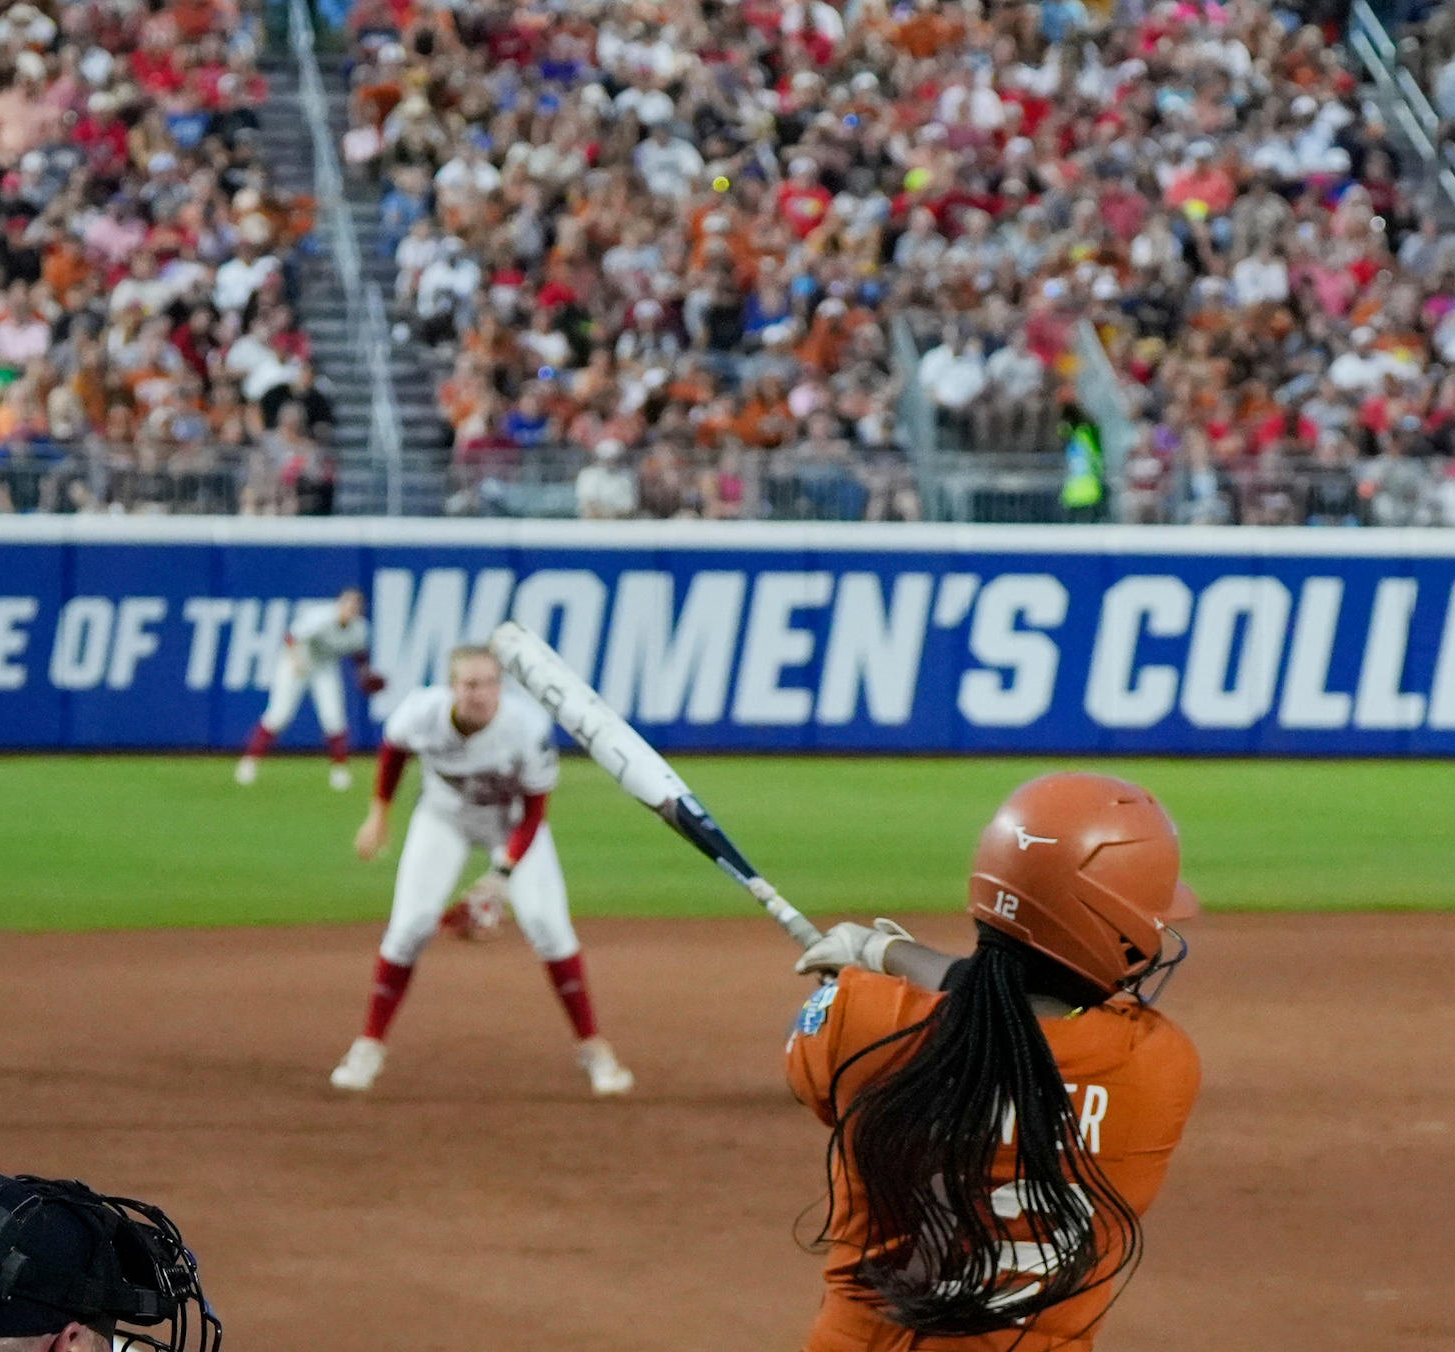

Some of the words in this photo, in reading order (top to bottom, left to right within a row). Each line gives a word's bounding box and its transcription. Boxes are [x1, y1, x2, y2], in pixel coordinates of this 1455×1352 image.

[48, 596, 166, 691] OF
[182, 596, 340, 692] TH
[368, 567, 1070, 729] WOMEN'S
[994, 890, 1020, 920] 12
